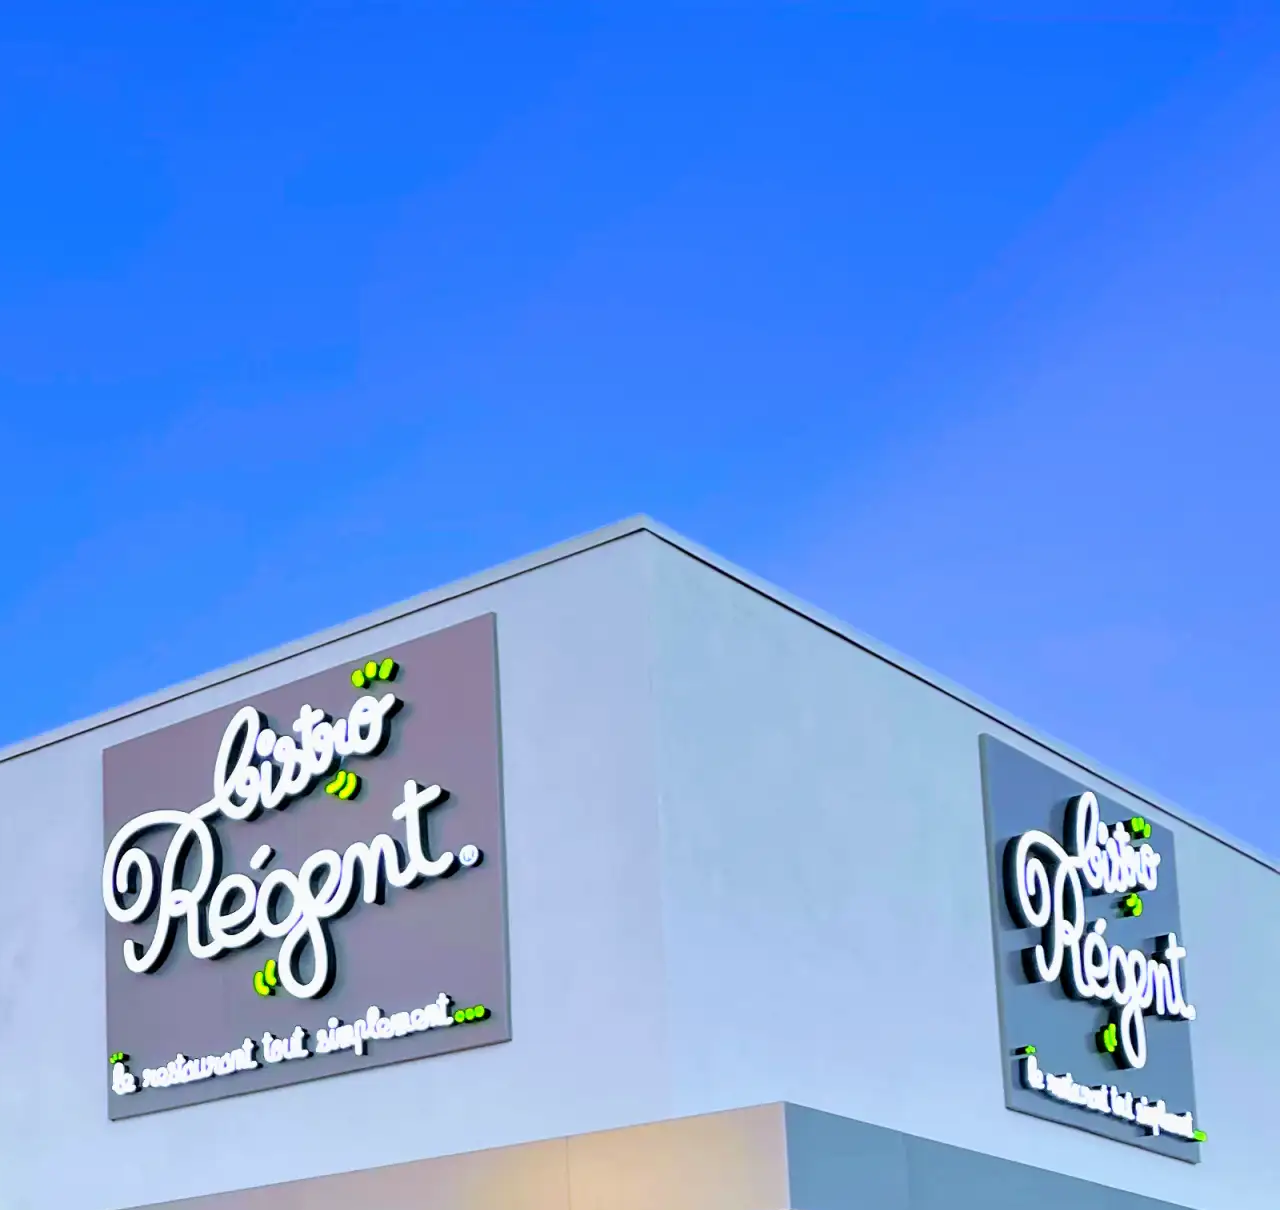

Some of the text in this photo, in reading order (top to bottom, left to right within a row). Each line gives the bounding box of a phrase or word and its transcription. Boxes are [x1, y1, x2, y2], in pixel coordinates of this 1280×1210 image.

[214, 693, 396, 820] bistro
[1077, 791, 1160, 892] bistro
[142, 1037, 258, 1088] restaurant
[261, 1026, 309, 1064] tout
